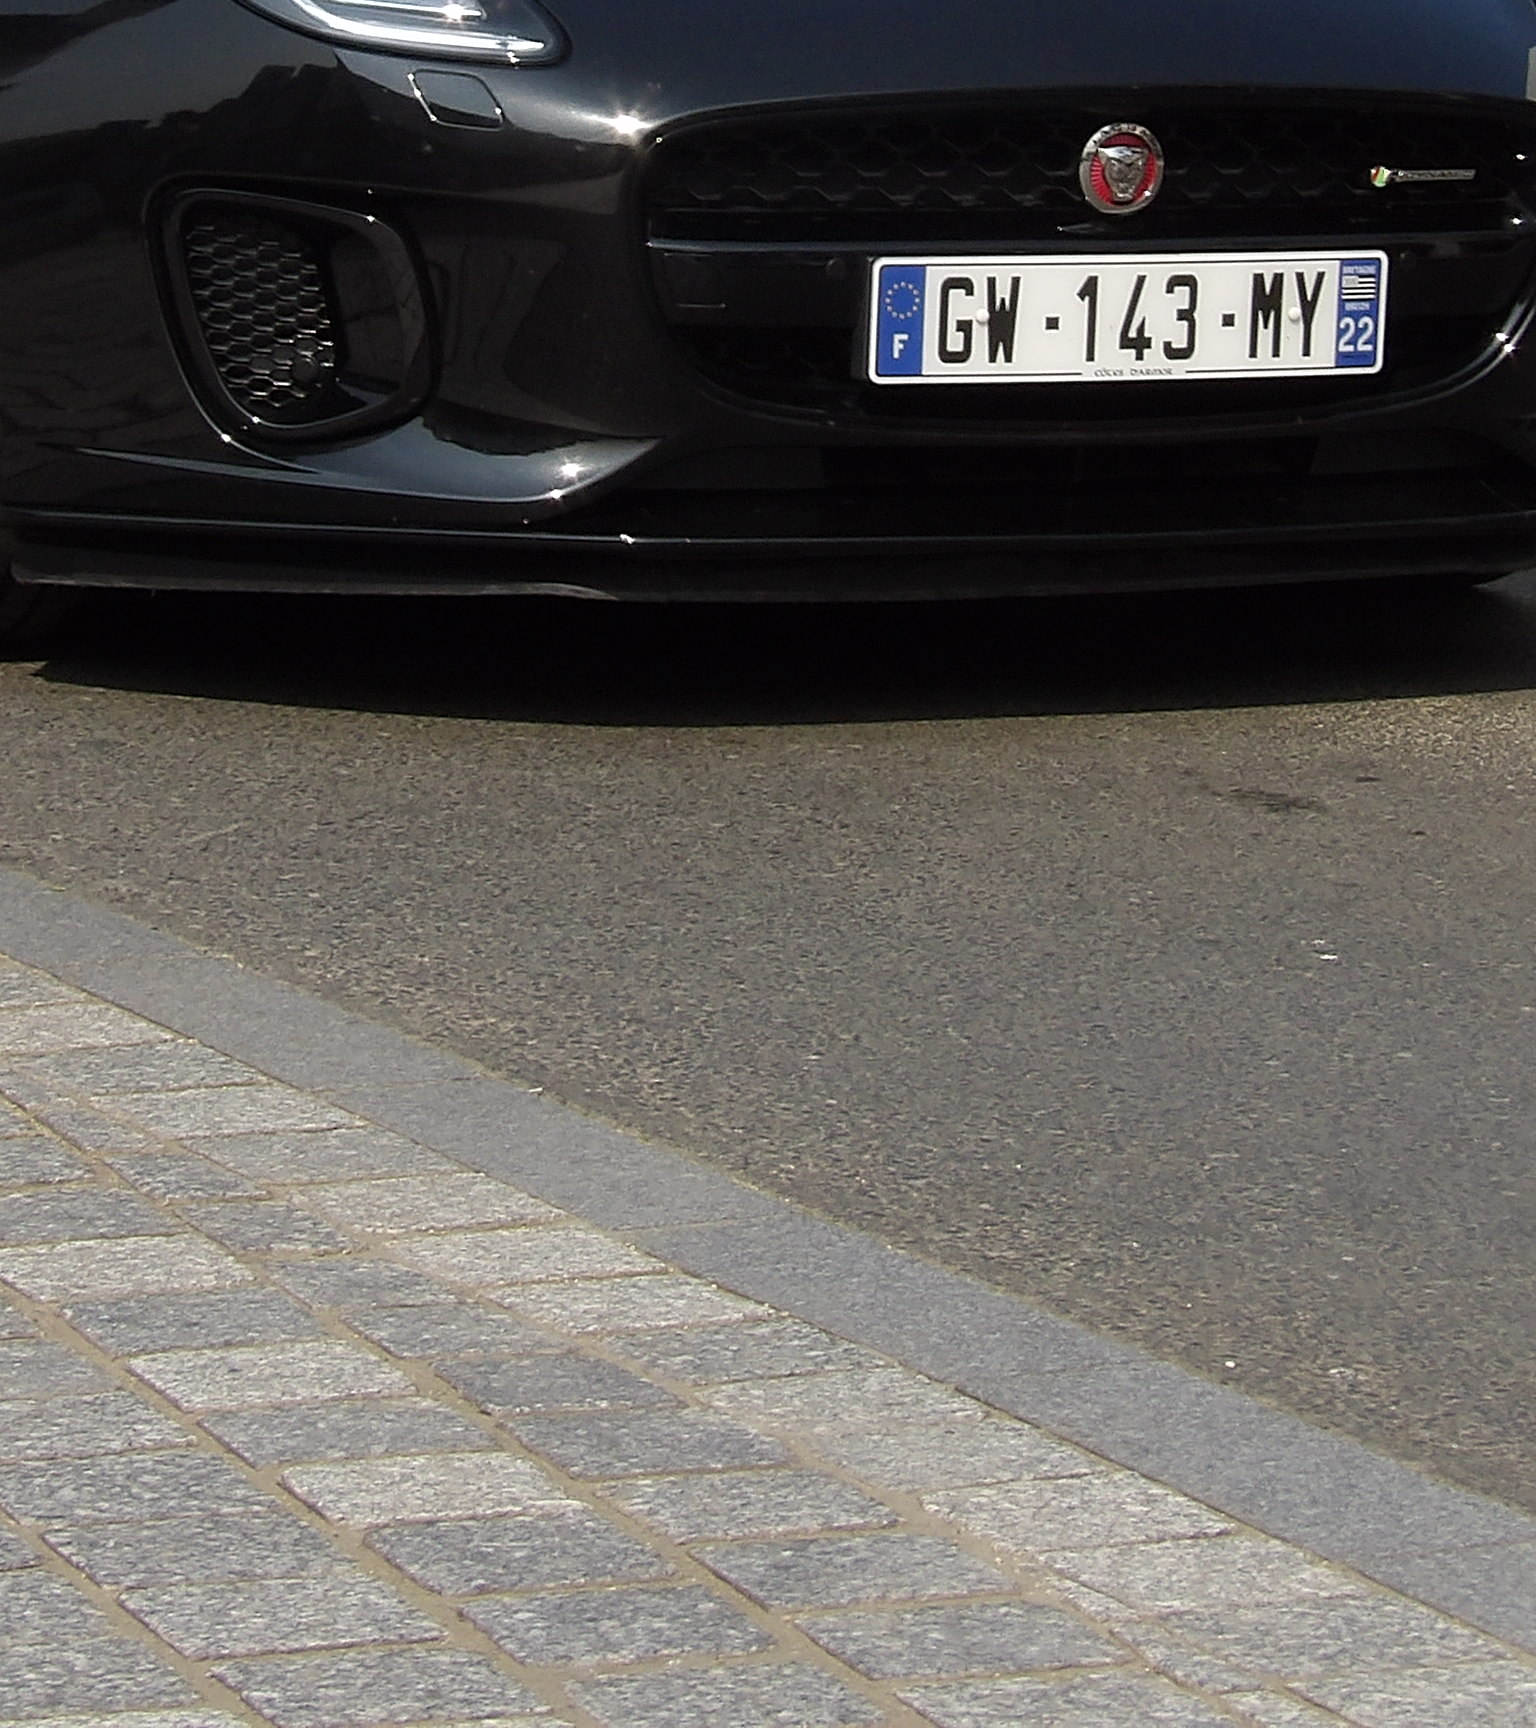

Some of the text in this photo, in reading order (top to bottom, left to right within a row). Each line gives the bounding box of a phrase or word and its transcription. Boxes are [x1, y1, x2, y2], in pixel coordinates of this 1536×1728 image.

[937, 271, 1327, 364] GW-143-MY
[1338, 316, 1374, 352] 22
[892, 333, 909, 359] F
